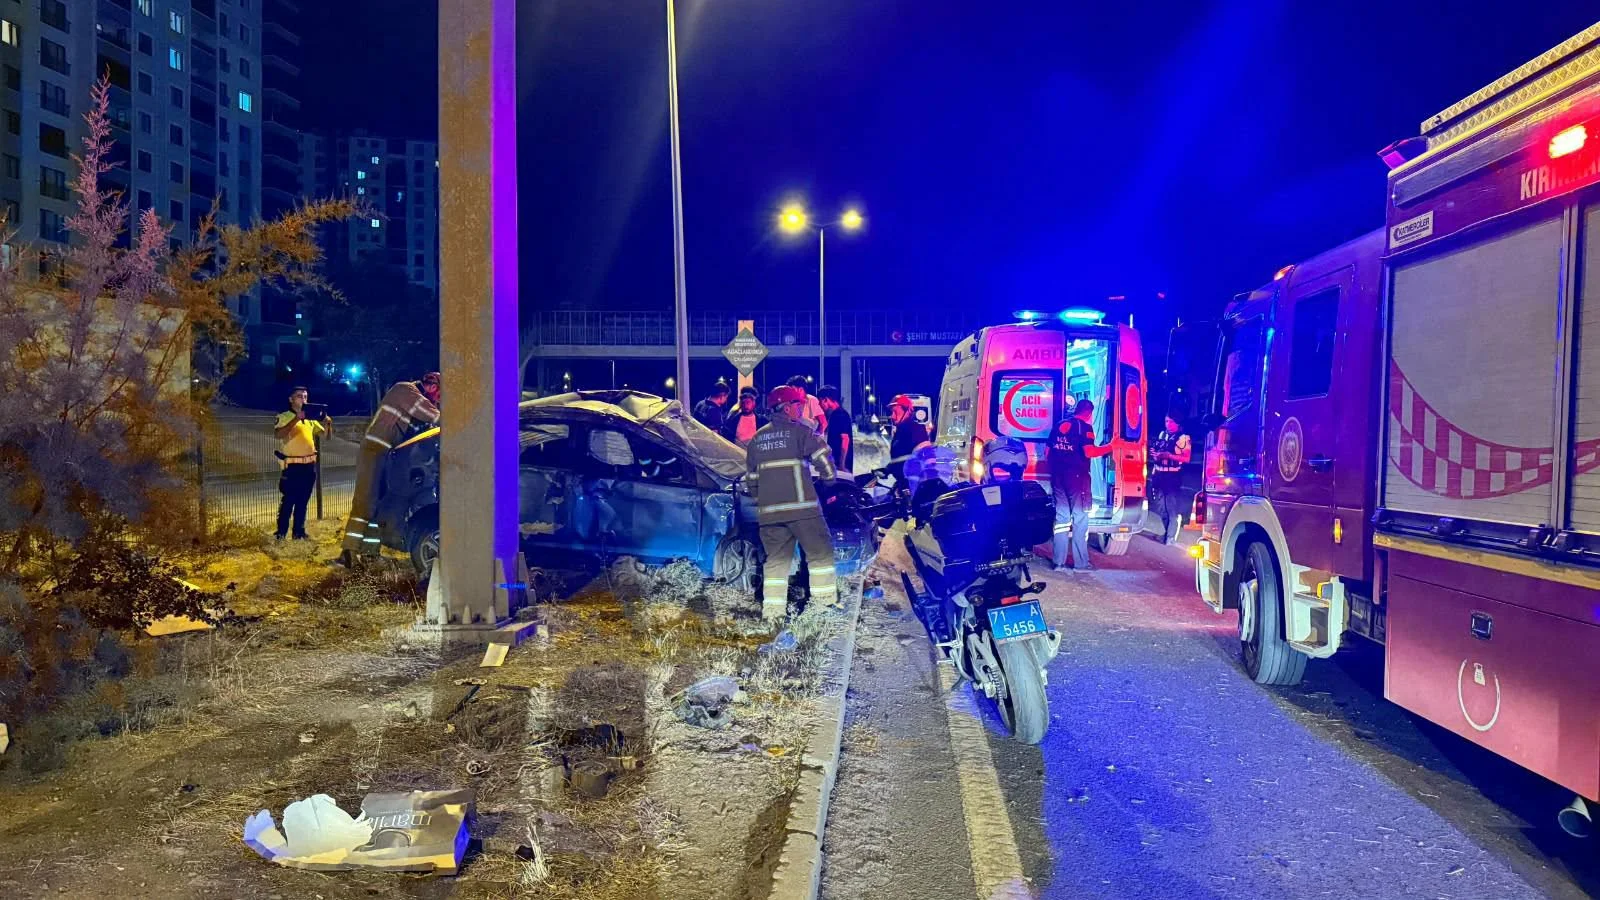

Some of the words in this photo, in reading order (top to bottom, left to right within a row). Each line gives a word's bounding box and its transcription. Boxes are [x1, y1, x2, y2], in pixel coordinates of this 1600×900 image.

[991, 610, 1006, 625] 71
[1030, 604, 1039, 617] A
[1003, 620, 1036, 636] 5456
